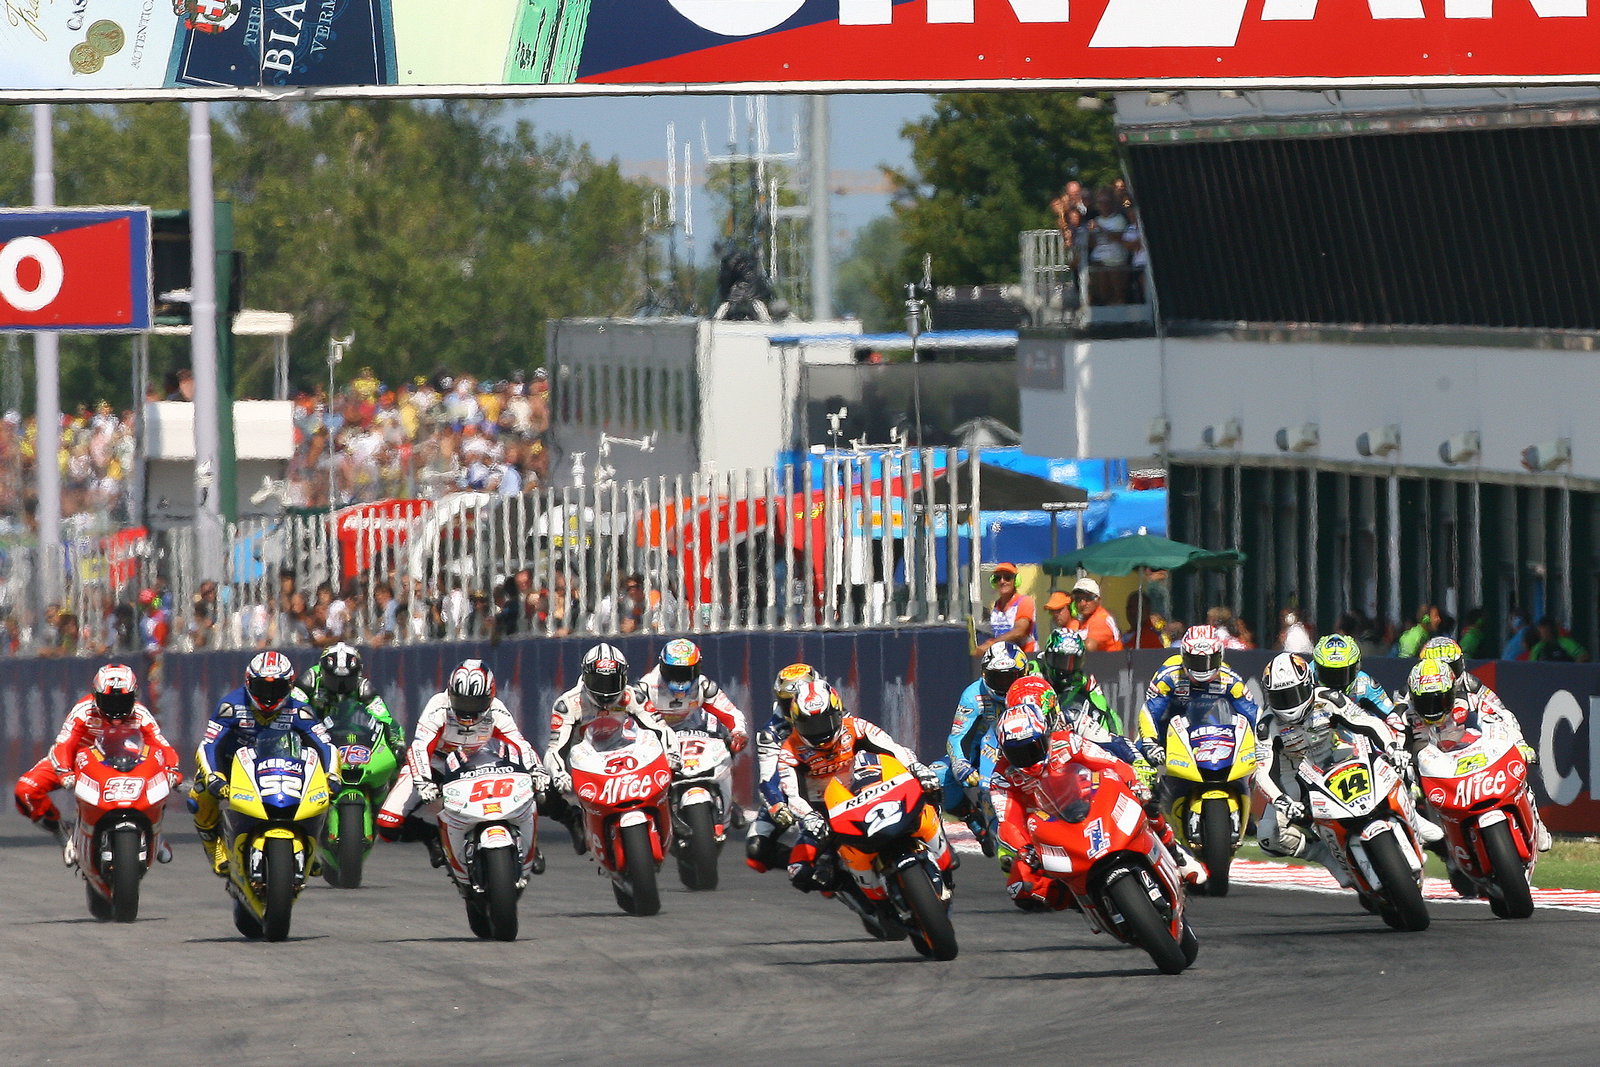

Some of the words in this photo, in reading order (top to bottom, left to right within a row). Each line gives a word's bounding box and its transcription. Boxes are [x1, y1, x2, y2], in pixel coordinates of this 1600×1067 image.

[243, 6, 261, 46] THE
[459, 766, 514, 779] MORELLATO
[603, 755, 639, 775] 50
[103, 777, 145, 802] 33
[259, 774, 303, 798] 52
[469, 778, 515, 803] 56
[599, 774, 652, 804] Alice
[845, 780, 900, 810] REPSOL
[1338, 772, 1369, 801] 14
[1453, 769, 1507, 808] Alice
